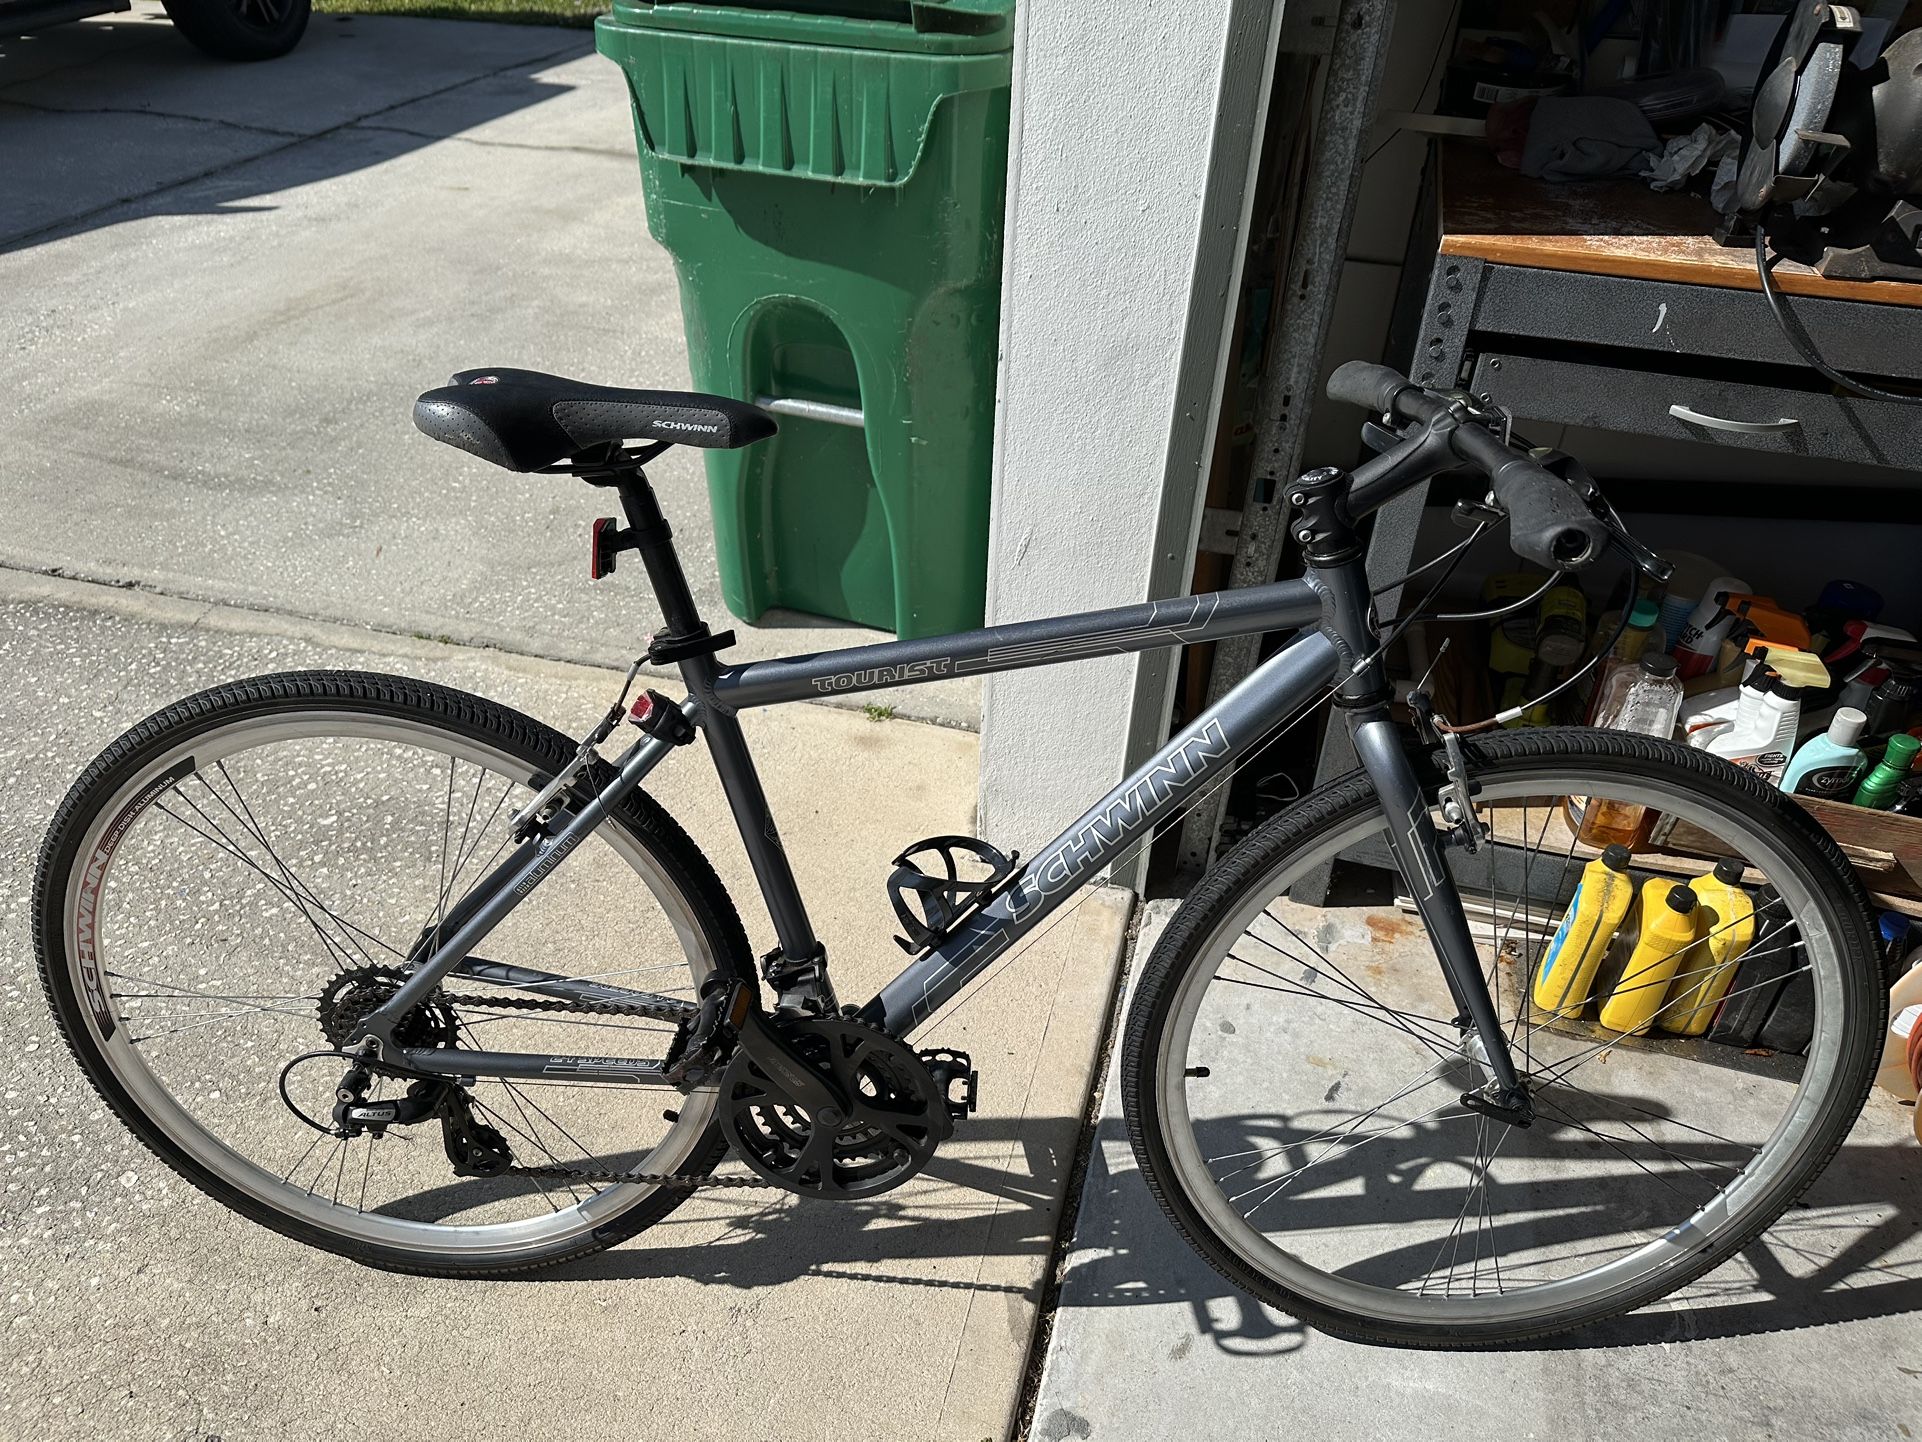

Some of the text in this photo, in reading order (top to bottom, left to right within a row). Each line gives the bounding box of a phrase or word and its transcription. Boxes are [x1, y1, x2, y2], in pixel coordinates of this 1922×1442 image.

[652, 419, 718, 434] SCHWINN
[811, 657, 951, 693] TOURIST
[1004, 717, 1232, 924] SCHWINN
[526, 835, 578, 883] aluminum
[77, 776, 175, 1014] SCHWINN DEEP DISH ALUMINUM
